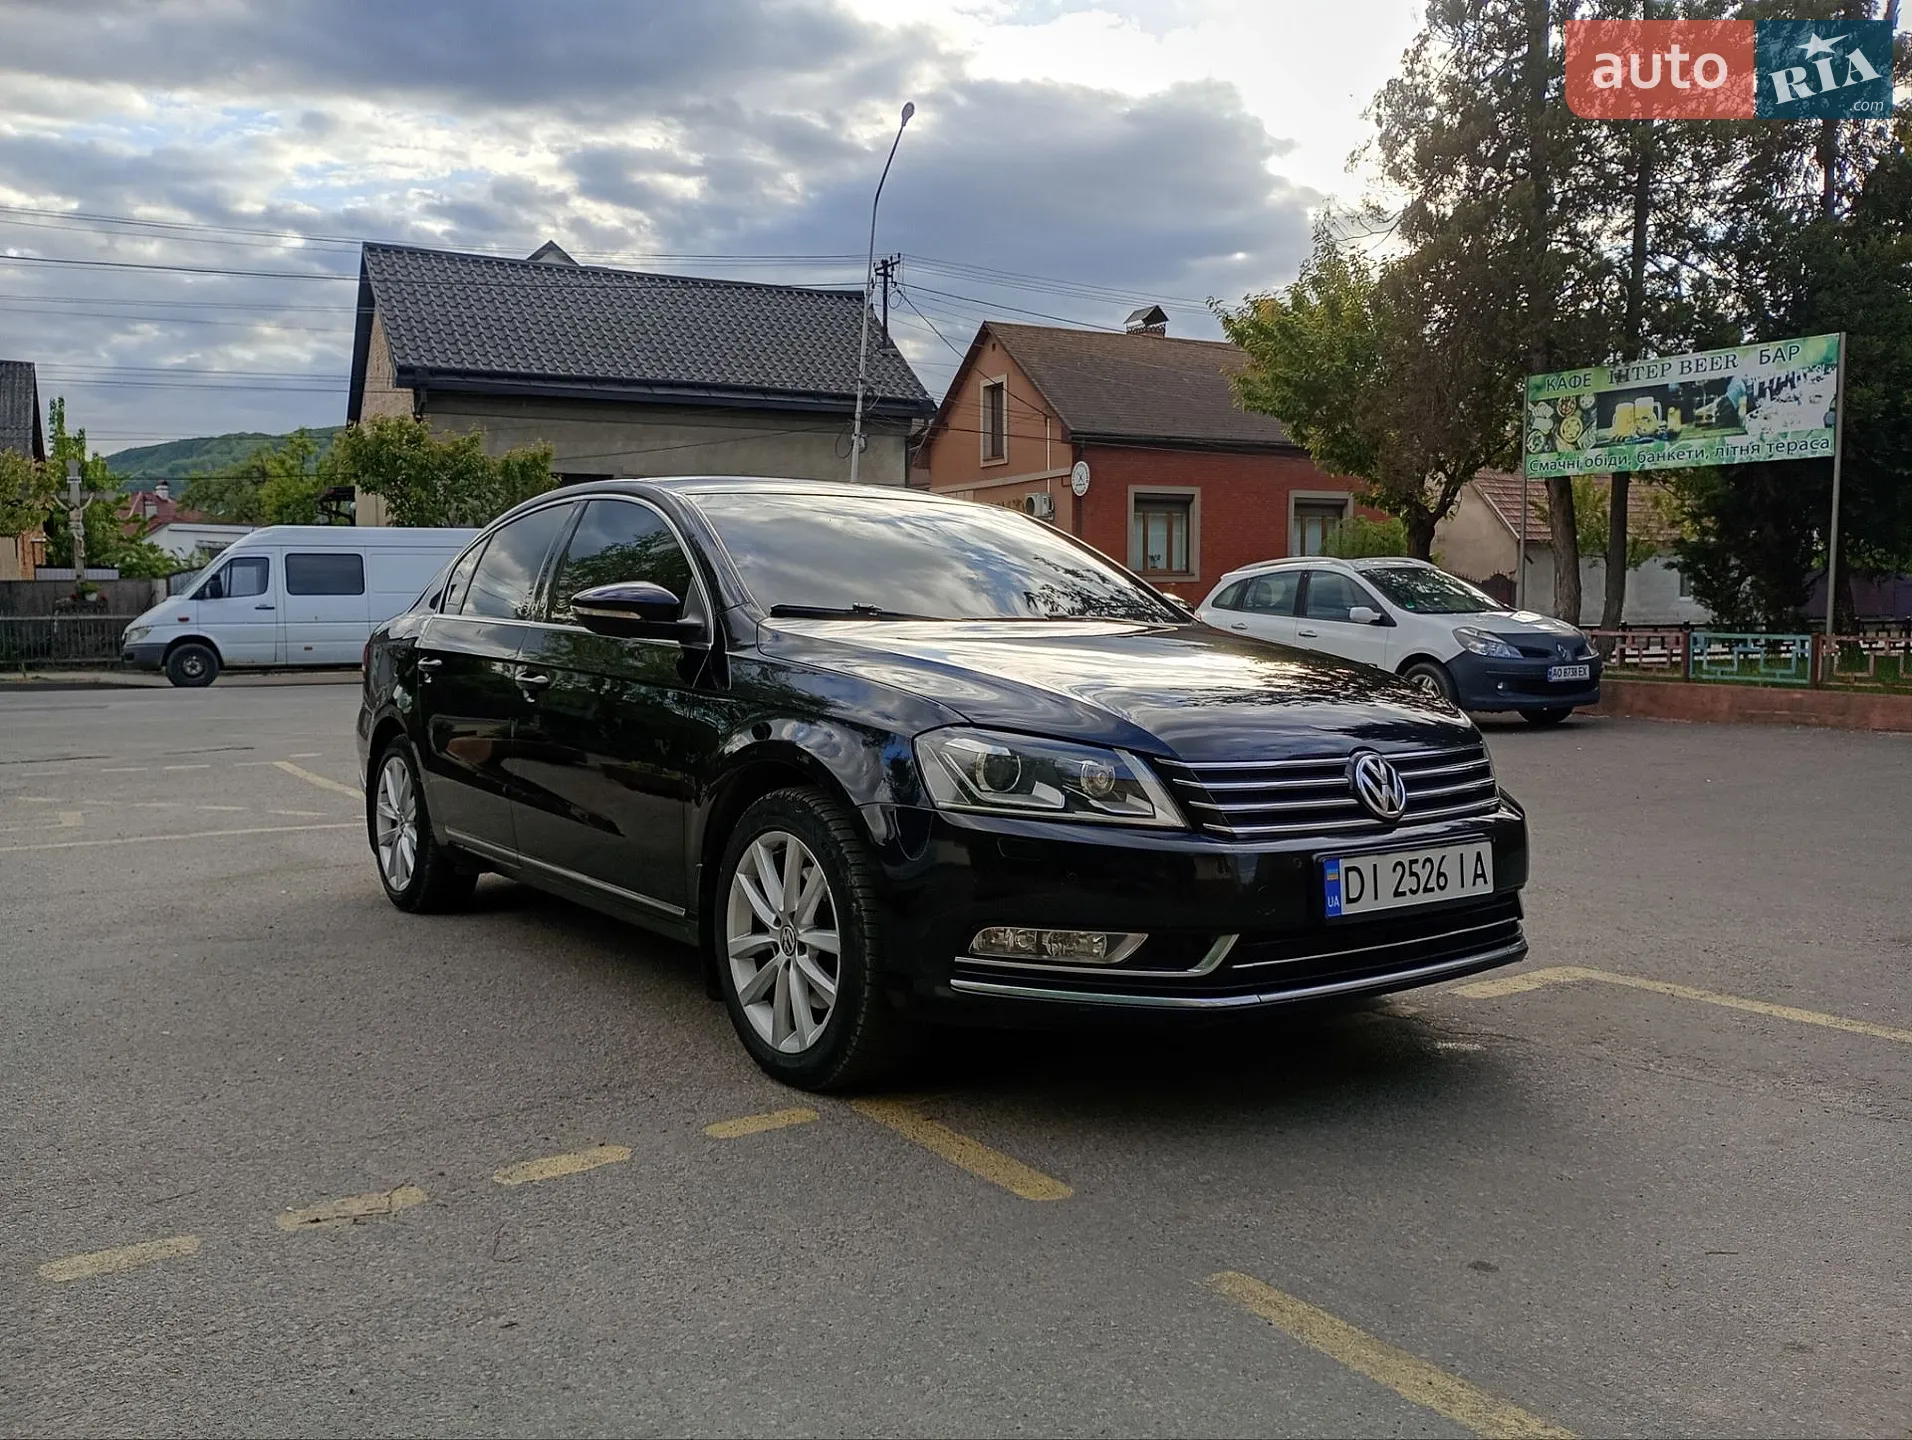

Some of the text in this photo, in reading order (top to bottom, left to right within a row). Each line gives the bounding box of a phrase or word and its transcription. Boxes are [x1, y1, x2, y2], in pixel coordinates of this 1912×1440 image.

[1546, 373, 1593, 392] КАФЕ
[1679, 353, 1739, 375] BEER
[1759, 345, 1800, 365] БАР
[1529, 456, 1580, 472] Смачні
[1636, 448, 1709, 464] банкети,
[1714, 442, 1760, 458] літня
[1766, 437, 1830, 455] тераса
[1344, 850, 1488, 904] DI 2526 IA
[1327, 895, 1340, 908] UA
